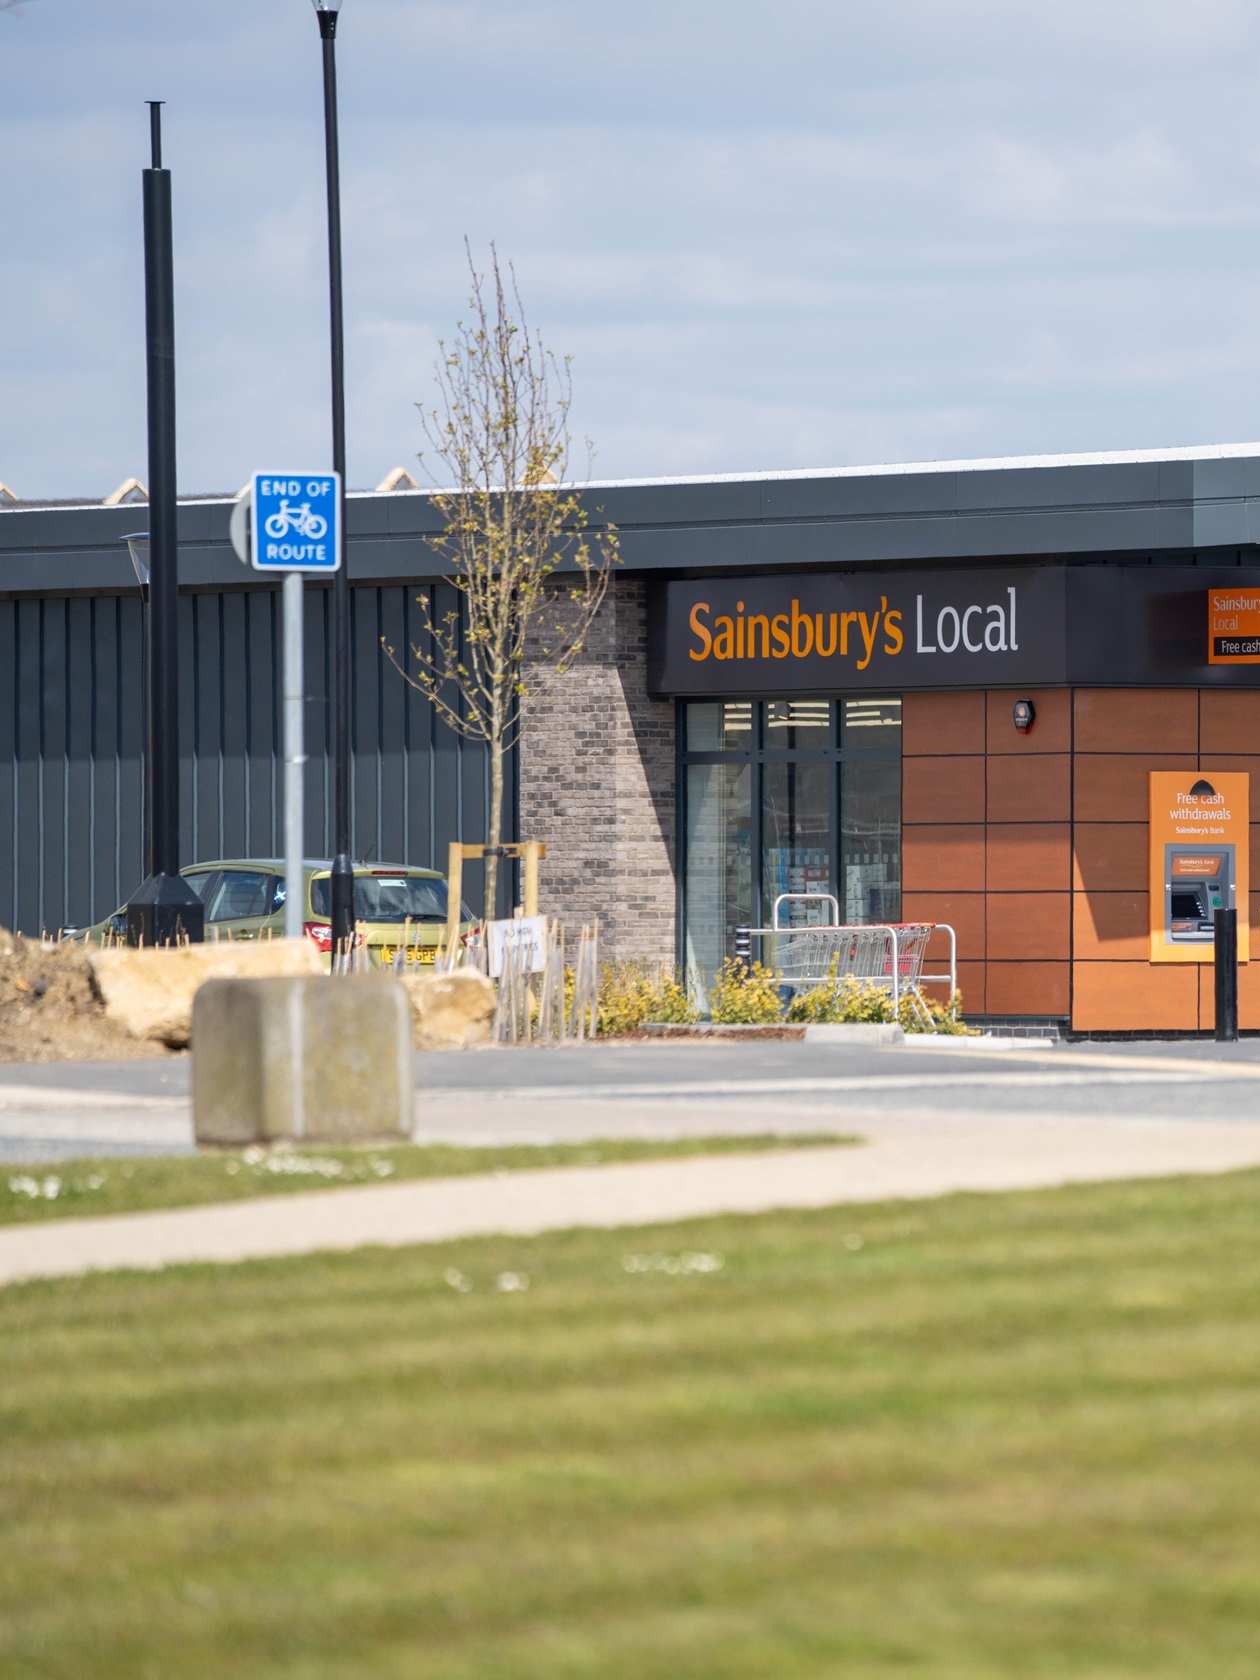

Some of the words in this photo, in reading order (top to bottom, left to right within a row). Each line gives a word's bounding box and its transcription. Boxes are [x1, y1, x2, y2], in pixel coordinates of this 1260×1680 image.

[261, 480, 301, 496] END
[306, 481, 331, 497] OF
[266, 543, 326, 560] ROUTE
[689, 596, 903, 670] Sainsbury's
[916, 587, 1019, 653] Local
[1213, 614, 1238, 631] Local
[1221, 640, 1240, 653] Free
[1176, 792, 1198, 804] Free
[1200, 793, 1224, 804] cash
[1170, 808, 1231, 820] withdrawals
[1176, 826, 1208, 836] Sainsbury's
